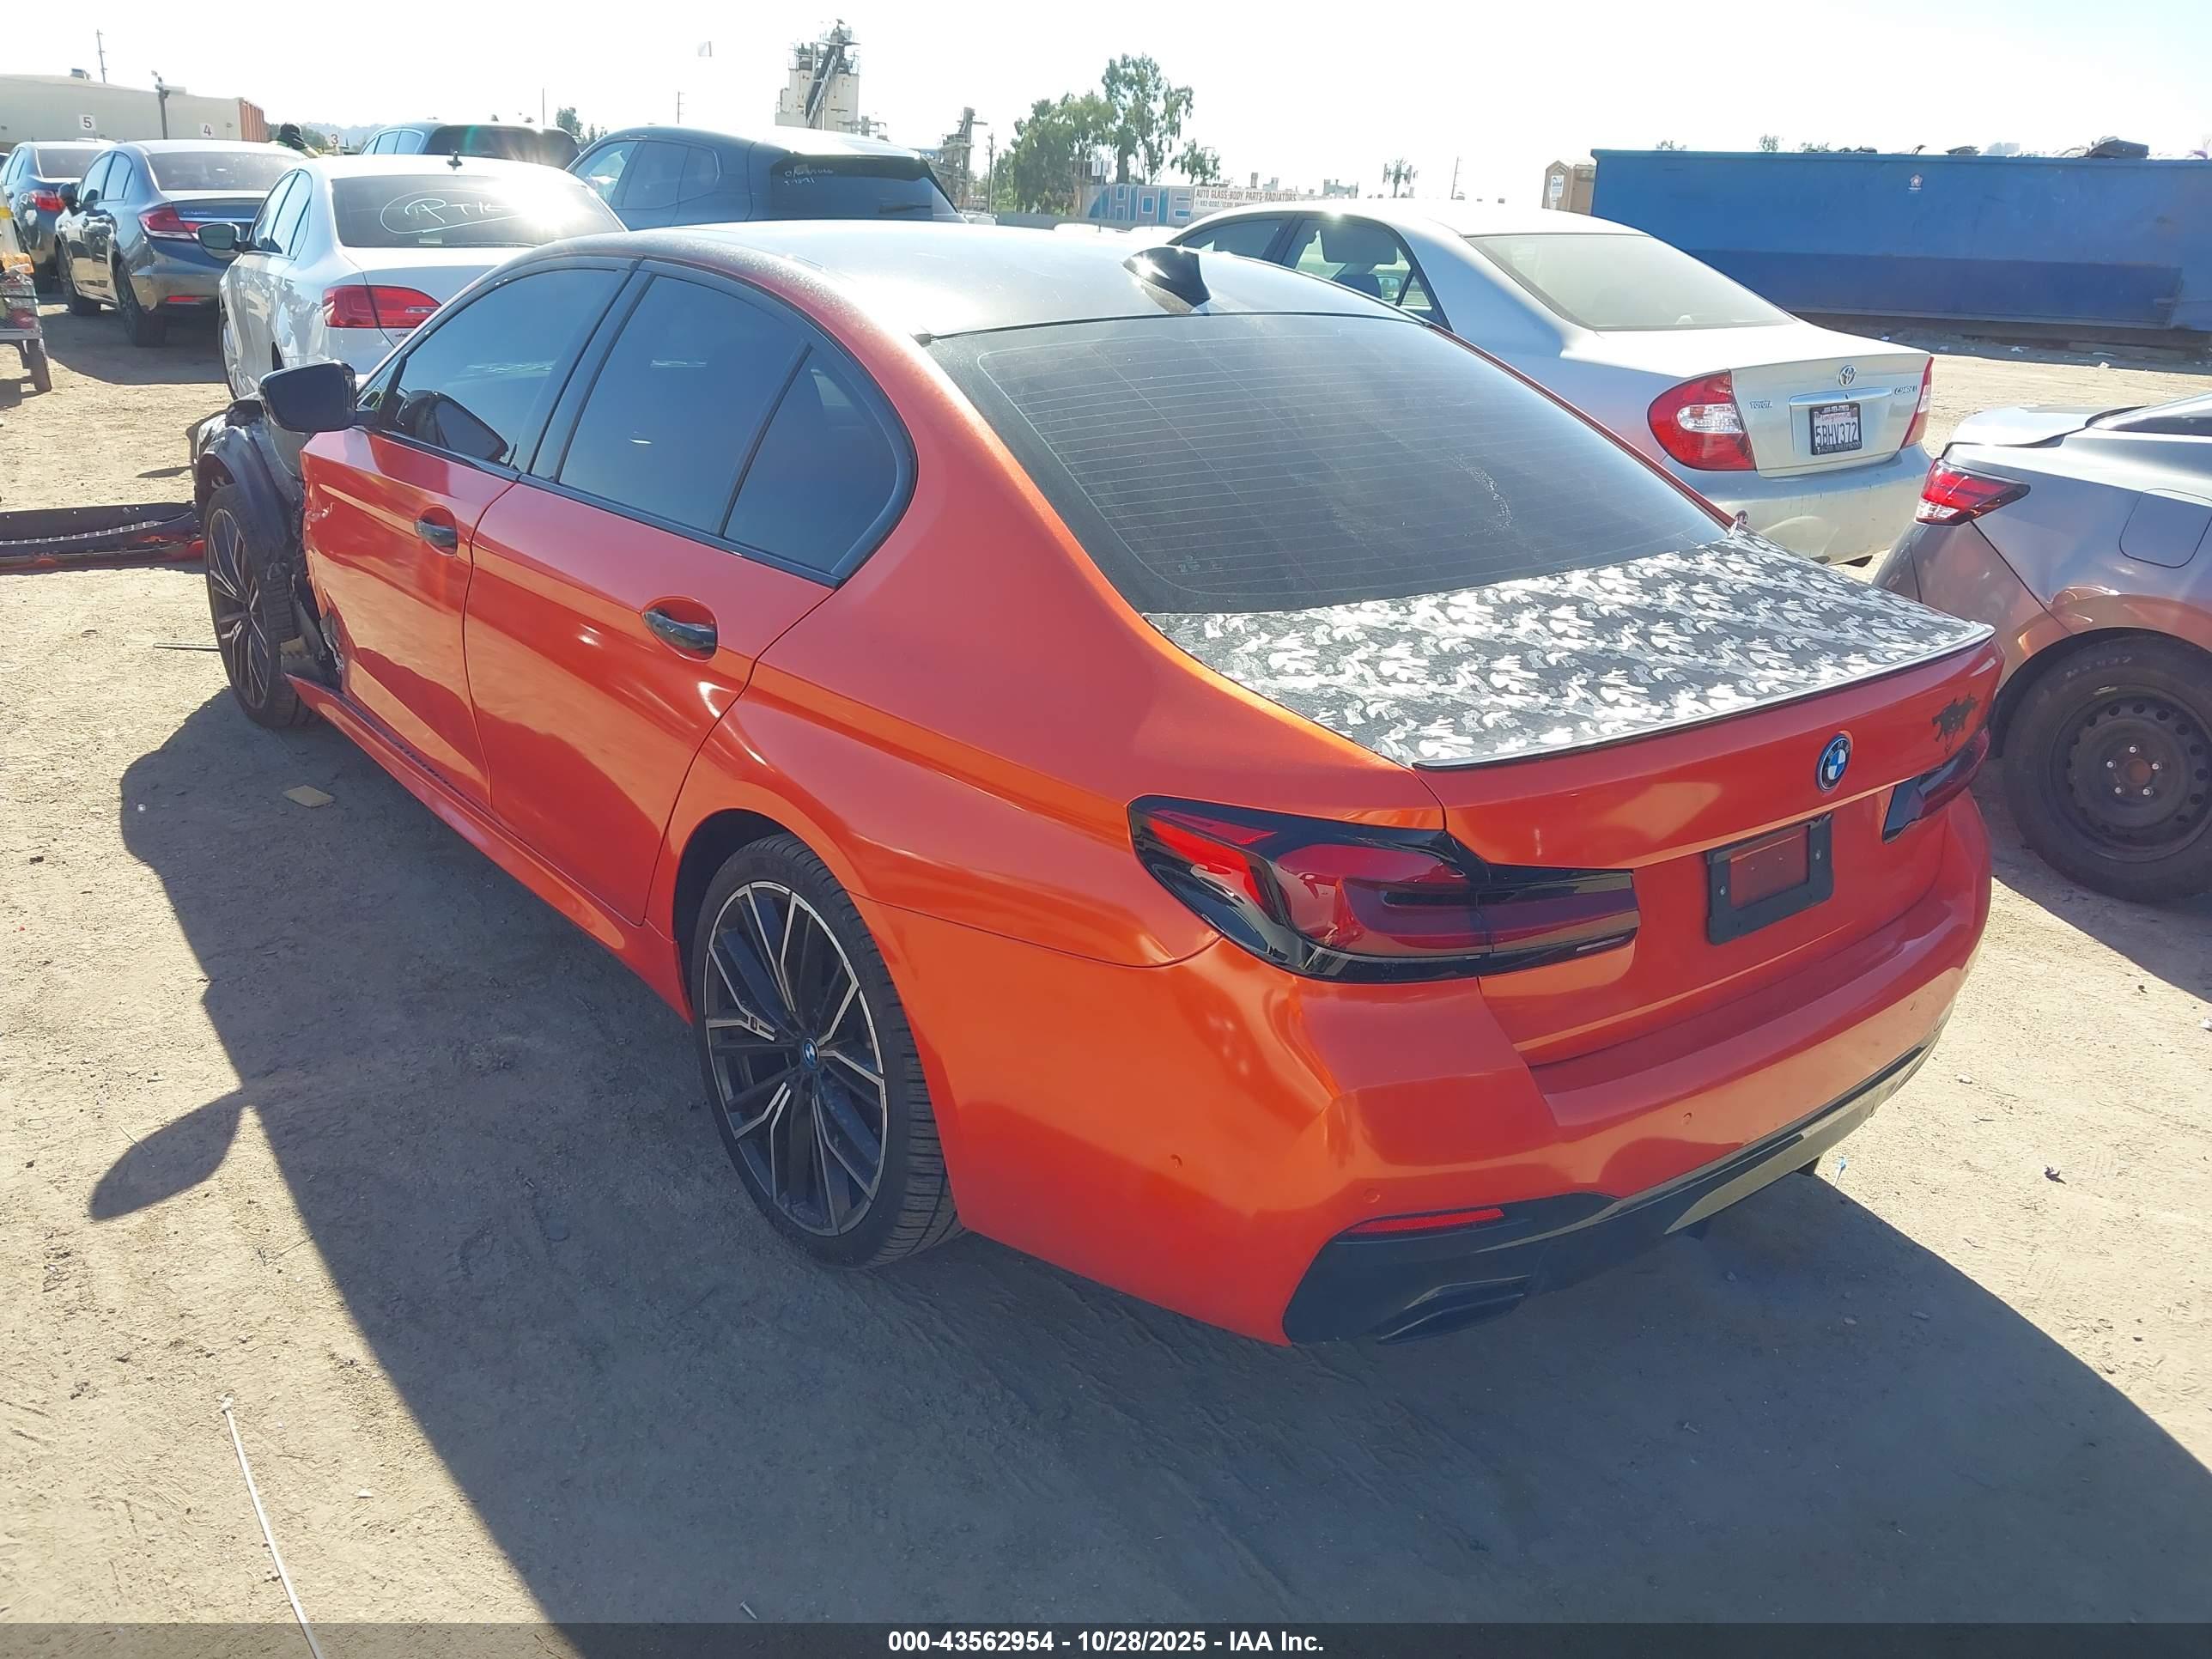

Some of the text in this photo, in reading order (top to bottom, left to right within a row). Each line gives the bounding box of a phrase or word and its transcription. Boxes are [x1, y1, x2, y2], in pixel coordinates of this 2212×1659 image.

[83, 116, 93, 129] 5
[203, 124, 213, 137] 4
[331, 133, 338, 145] 3
[1196, 188, 1210, 198] AUTO
[1815, 422, 1857, 447] 5BHV372
